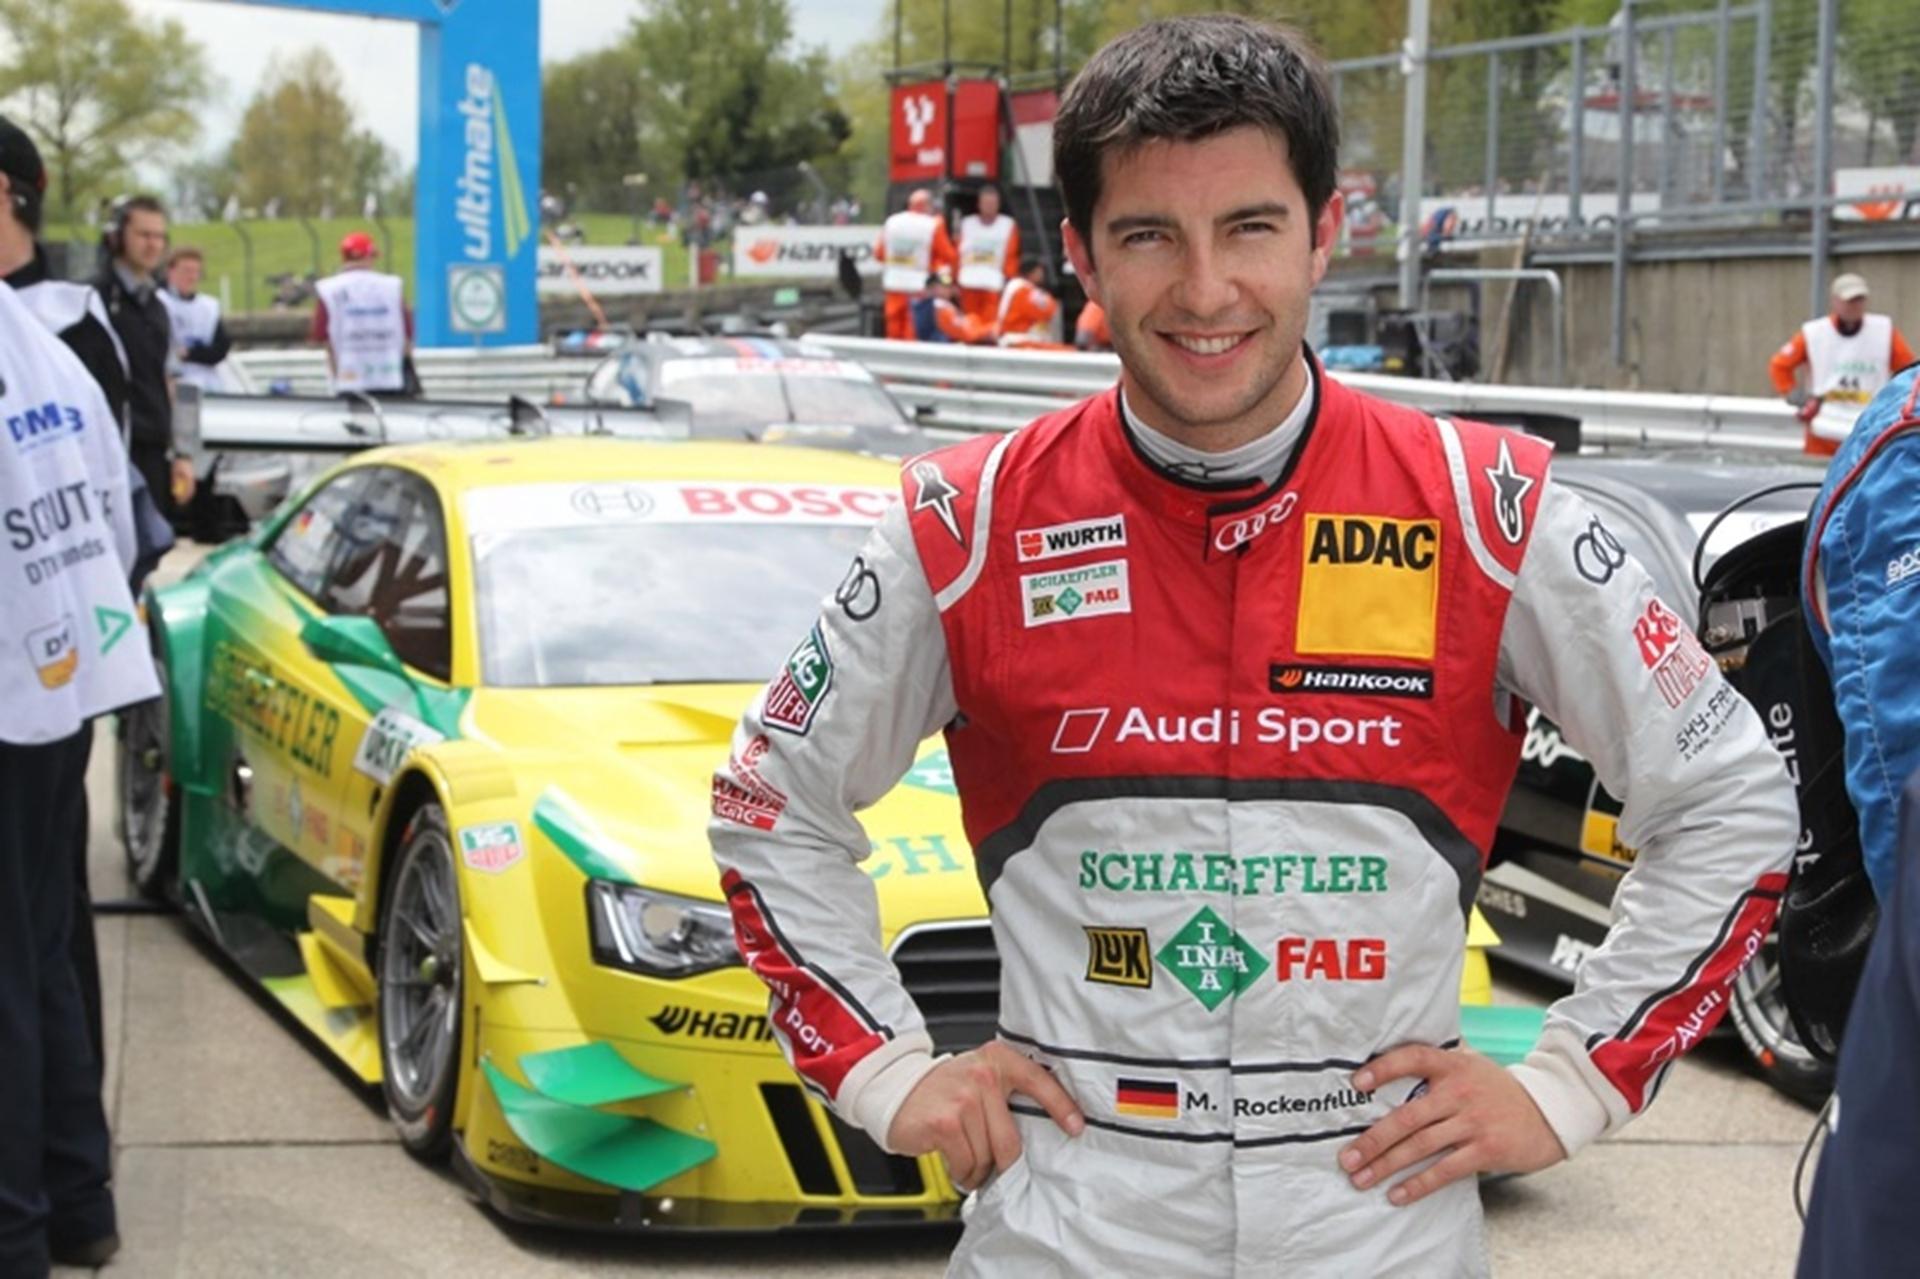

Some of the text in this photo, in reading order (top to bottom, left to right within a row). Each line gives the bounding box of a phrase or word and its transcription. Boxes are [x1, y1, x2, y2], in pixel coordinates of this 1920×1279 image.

[457, 62, 494, 260] ultimate
[679, 487, 898, 518] BOSC
[1046, 523, 1122, 550] WURTH
[1308, 519, 1436, 571] ADAC
[1085, 587, 1119, 604] FAG
[1116, 707, 1402, 752] Audi Sport
[1079, 851, 1388, 895] SCHAEFFLER
[1277, 937, 1387, 981] FAG
[1675, 990, 1722, 1049] Audi
[1185, 1091, 1218, 1111] M.
